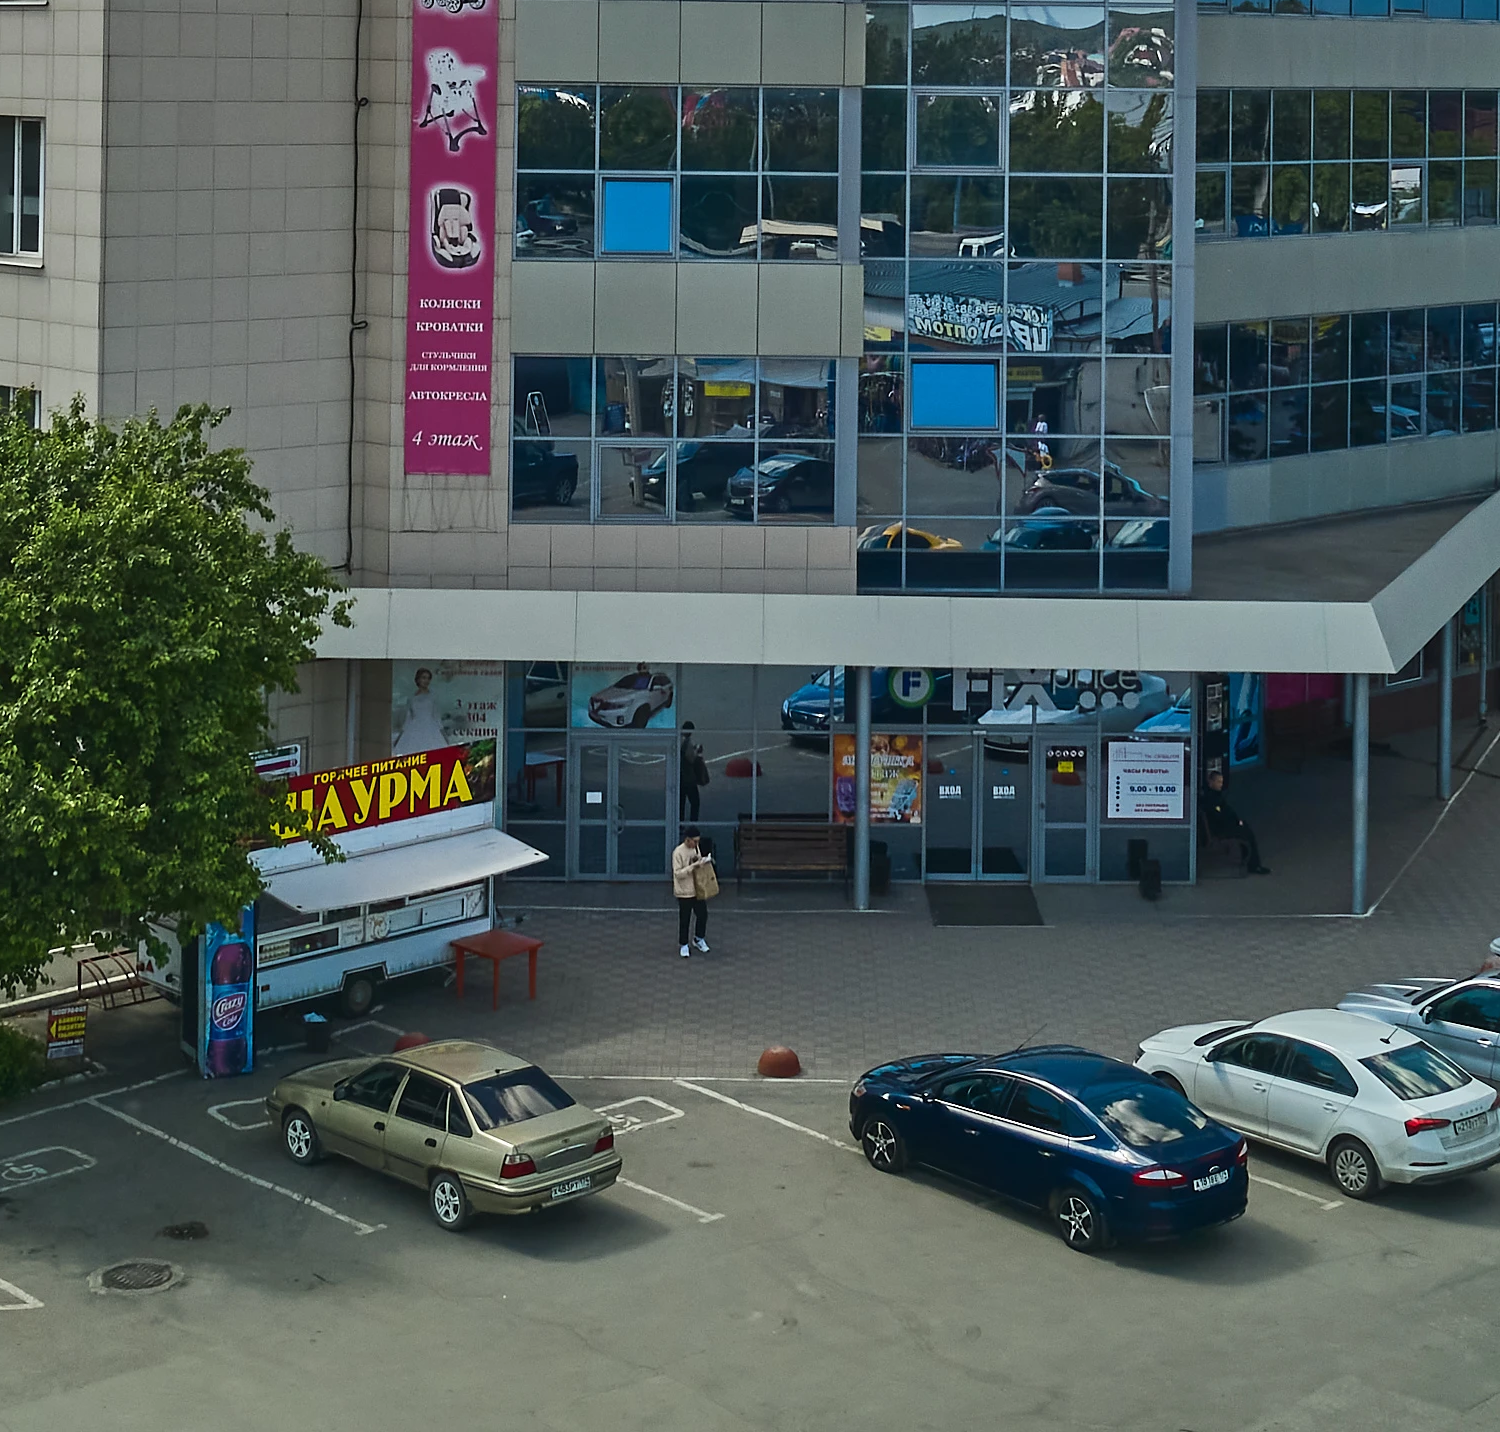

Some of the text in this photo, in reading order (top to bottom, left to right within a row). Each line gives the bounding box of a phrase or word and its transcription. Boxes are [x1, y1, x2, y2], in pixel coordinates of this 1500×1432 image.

[420, 298, 481, 310] КОЛЯСКИ
[416, 321, 484, 333] КРОВАТКИ
[421, 351, 477, 360] СТУЛЬЧИКИ
[410, 363, 488, 372] ДЛЯ КОРМЛЕНИЯ
[409, 391, 488, 401] АВТОКРЕСЛА
[412, 430, 484, 451] 4 этаж
[902, 670, 922, 697] F
[314, 754, 428, 786] ГОРЯЧЕЕ ПИТАНИЕ
[939, 785, 962, 796] ВХОД
[993, 785, 1015, 796] ВХОД
[215, 994, 244, 1017] Crazy
[222, 1013, 238, 1027] Cola
